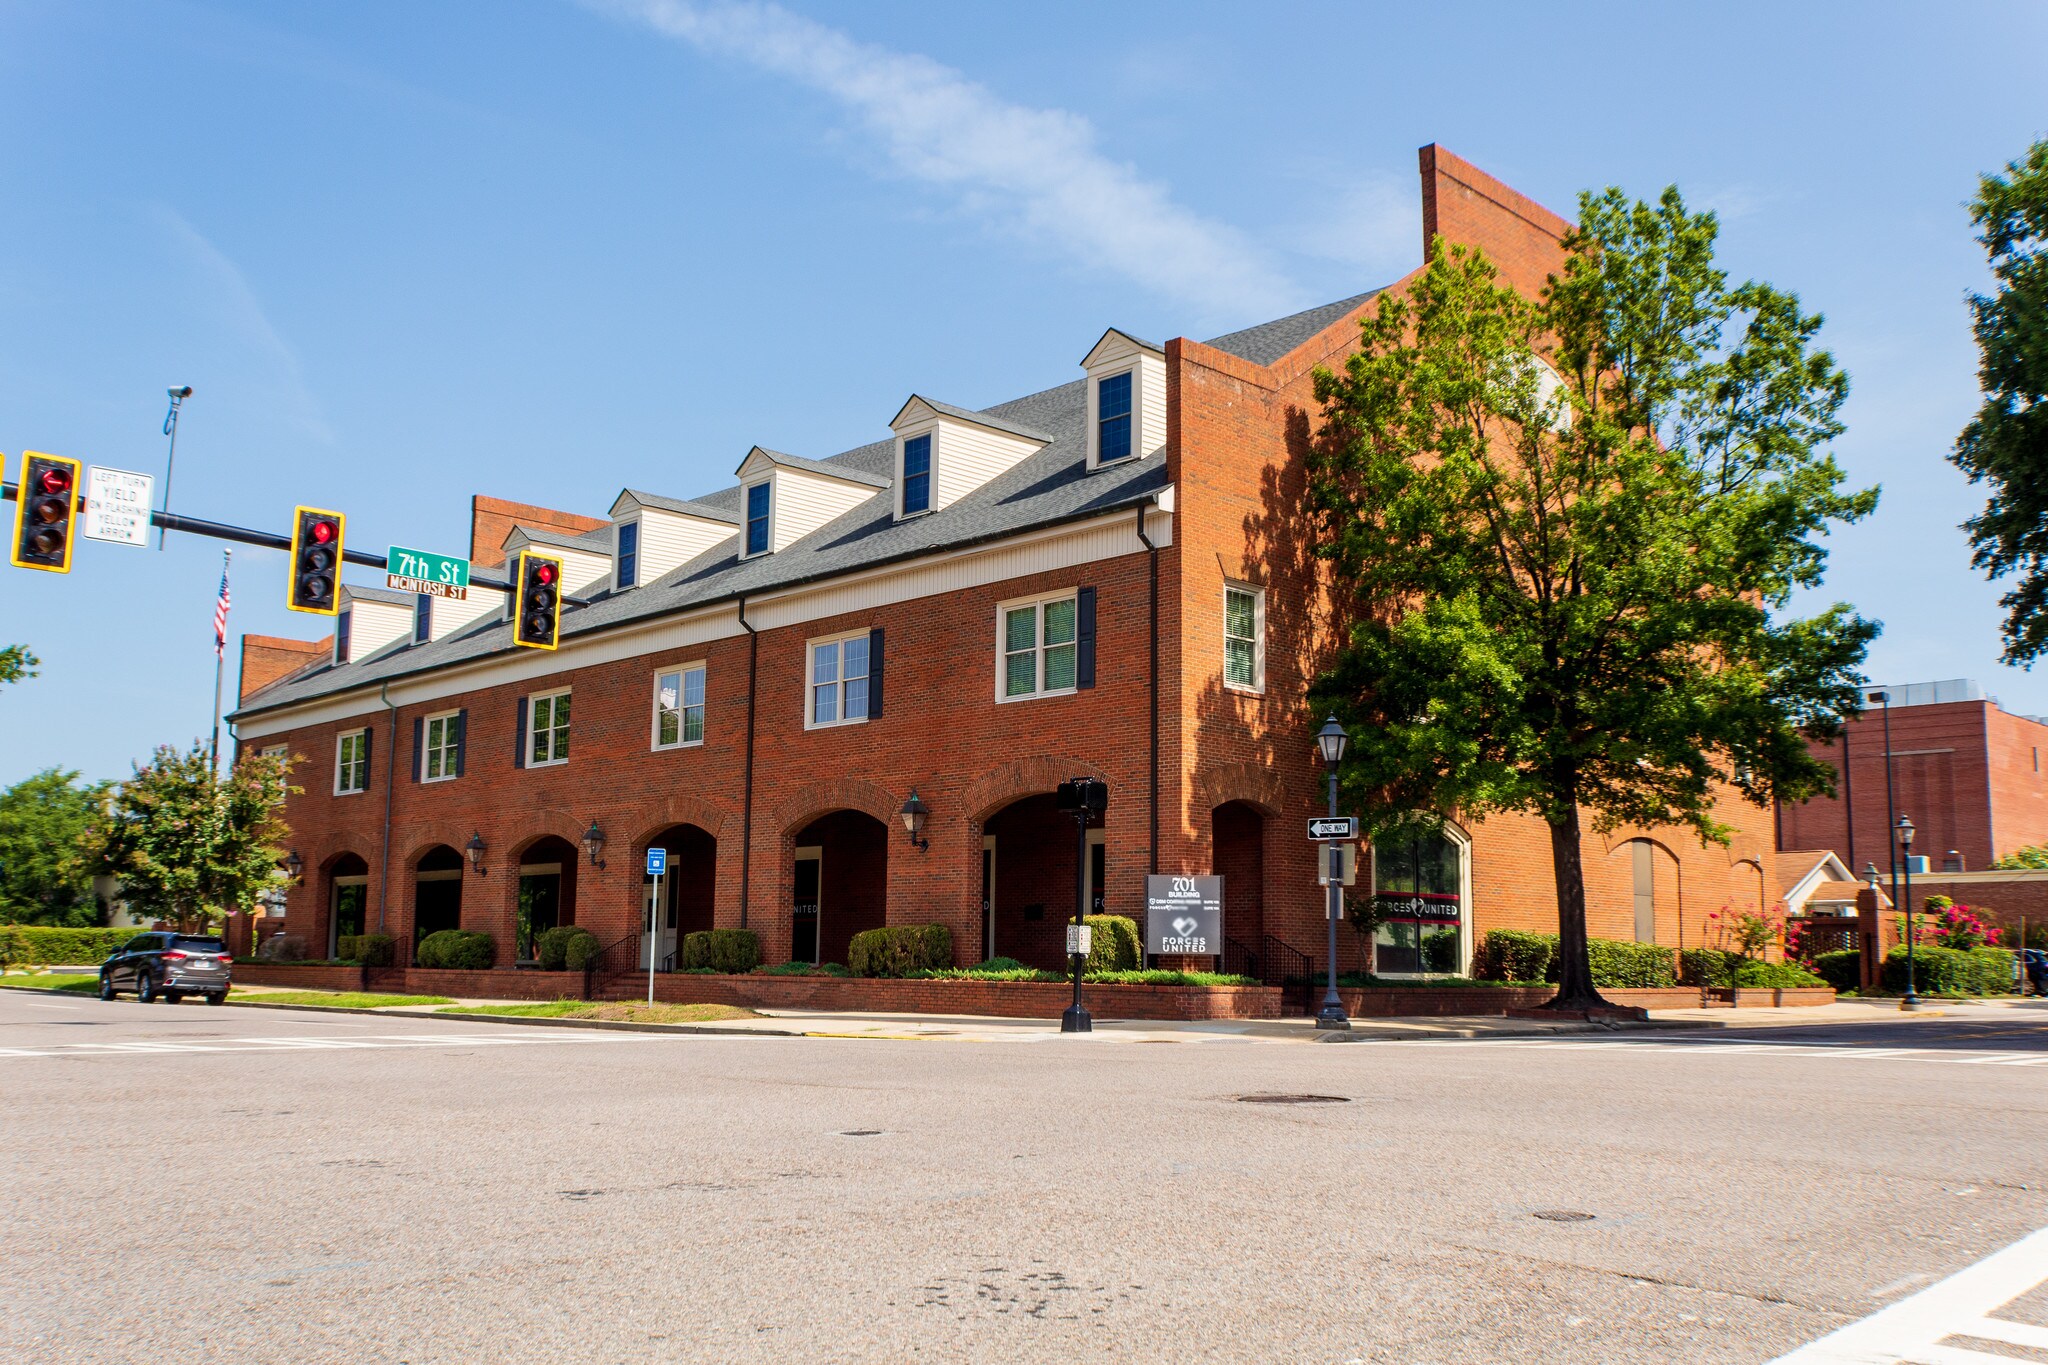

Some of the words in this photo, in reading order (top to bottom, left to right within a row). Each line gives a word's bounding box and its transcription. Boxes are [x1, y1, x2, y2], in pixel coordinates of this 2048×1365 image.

[96, 472, 118, 483] LEFT
[122, 476, 146, 487] TURN
[103, 486, 137, 502] YIELD
[90, 500, 101, 509] ON
[105, 502, 148, 517] FLASHING
[99, 513, 135, 527] YELLOW
[100, 527, 132, 538] ARROW
[398, 553, 429, 579] 7th
[439, 561, 460, 585] St
[390, 575, 446, 596] MCINTOSH
[449, 585, 464, 599] ST
[1320, 824, 1333, 833] ONE
[1334, 824, 1346, 832] WAY
[1172, 877, 1196, 892] 701
[793, 904, 818, 913] NITED
[1424, 903, 1458, 916] UNITED
[1162, 937, 1206, 945] FORCES
[1162, 944, 1206, 953] UNITED
